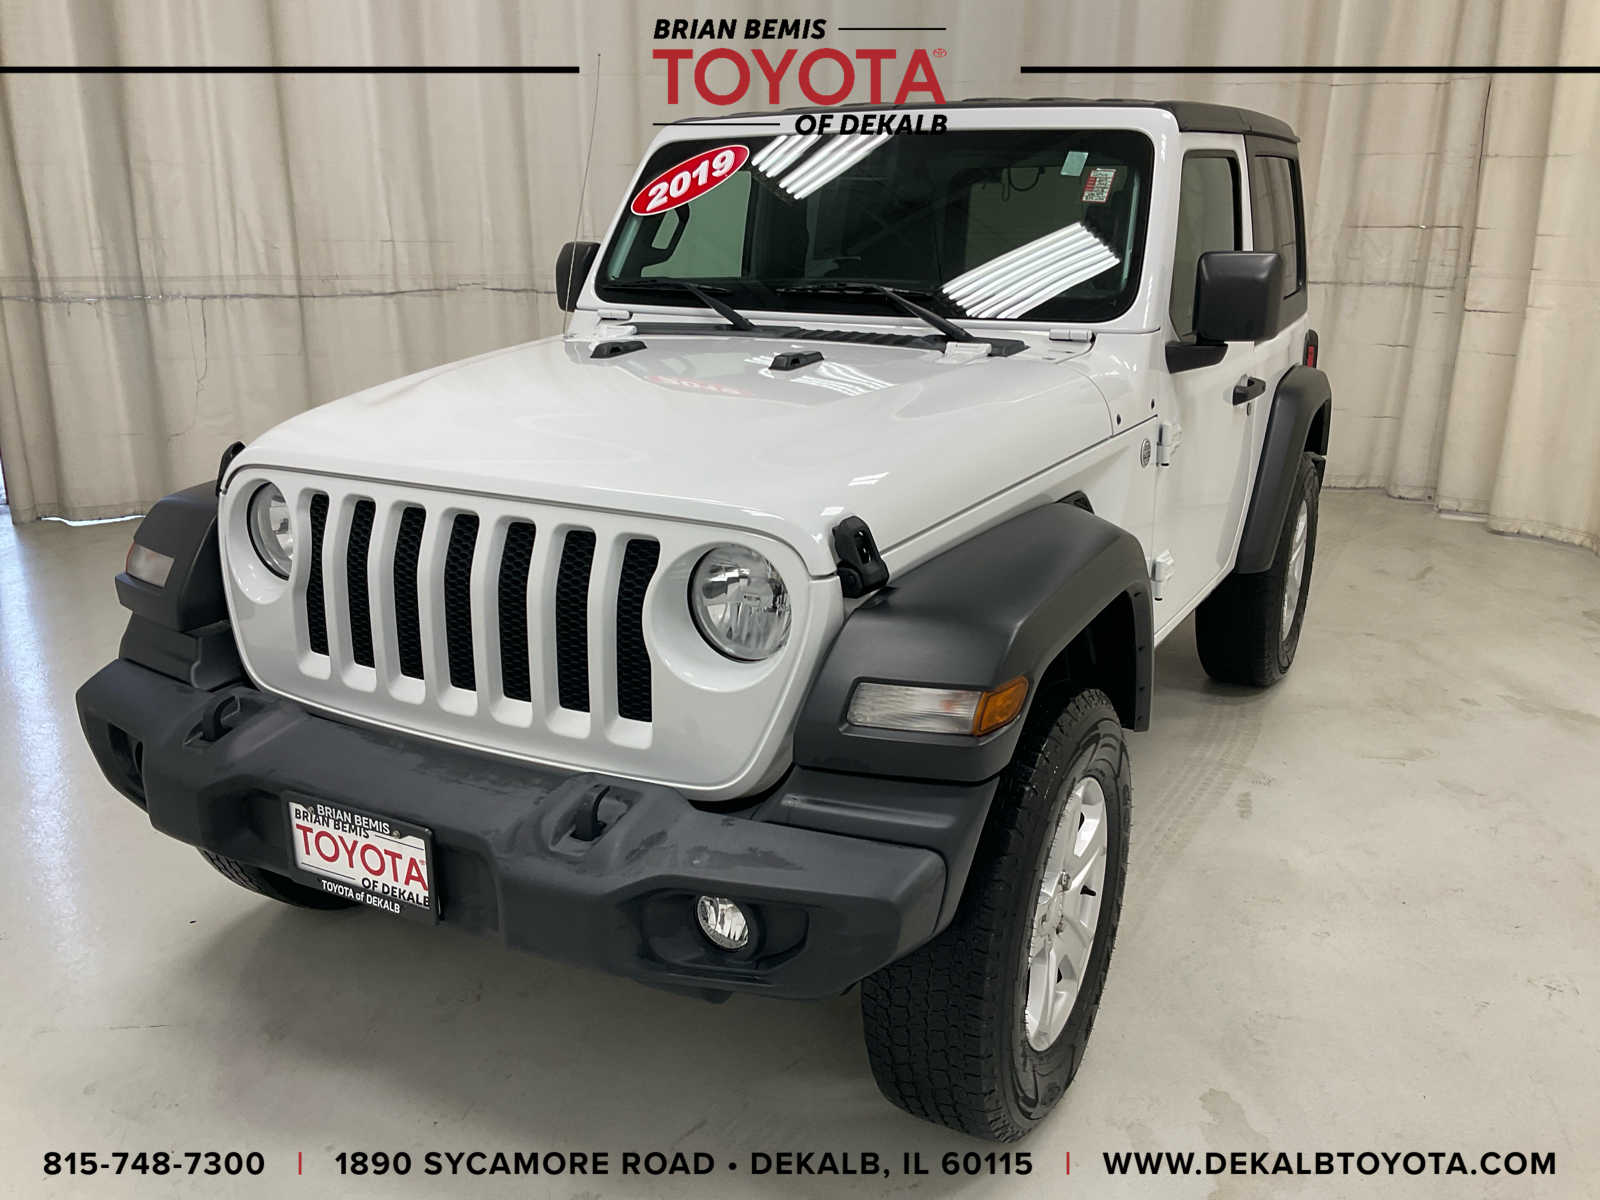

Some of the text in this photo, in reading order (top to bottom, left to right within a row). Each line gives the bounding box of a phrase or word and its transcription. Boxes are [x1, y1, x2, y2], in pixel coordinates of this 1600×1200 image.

[645, 150, 735, 212] 2019
[294, 808, 330, 828] BRIAN
[316, 804, 390, 834] BRIAN BEMIS
[296, 824, 429, 891] TOYOTA
[321, 879, 400, 914] TOYOTA of DEKALB
[361, 877, 380, 891] OF
